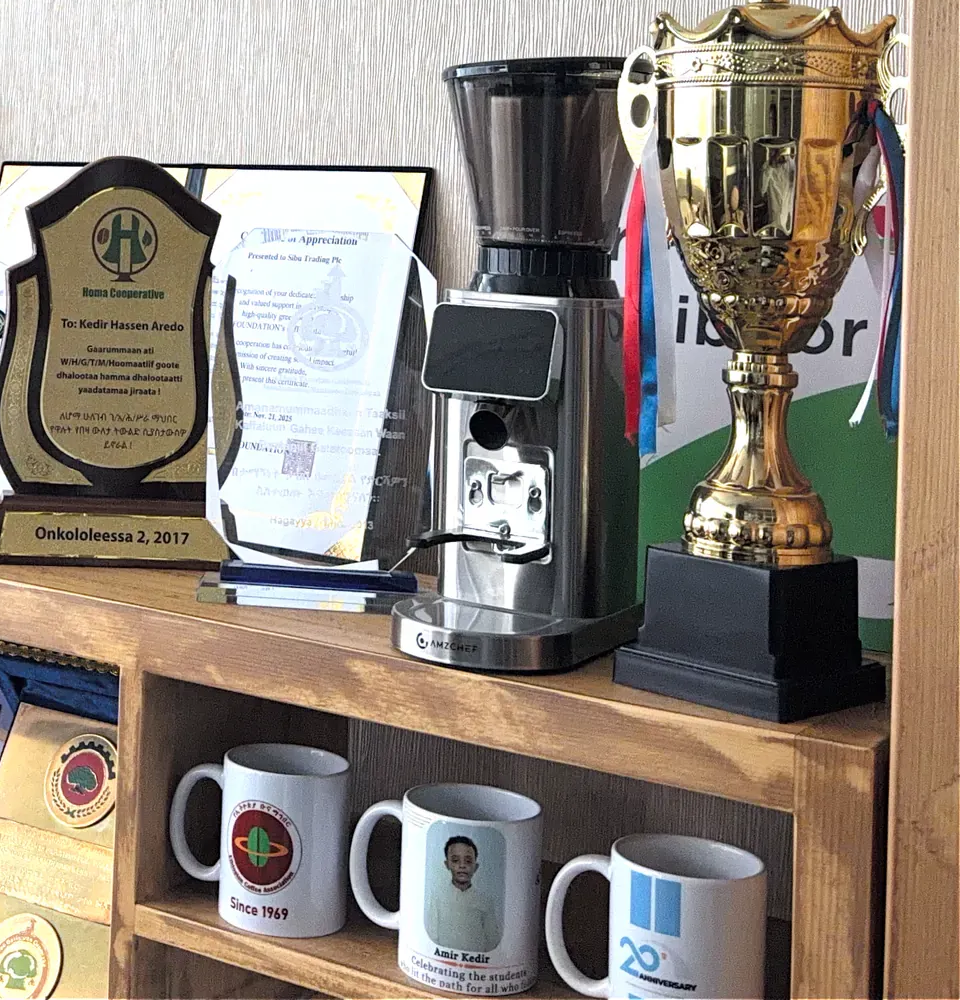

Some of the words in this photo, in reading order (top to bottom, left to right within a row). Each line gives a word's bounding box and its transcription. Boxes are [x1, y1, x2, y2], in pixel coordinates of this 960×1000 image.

[298, 234, 358, 247] Appreciation
[248, 252, 279, 261] Presented
[288, 253, 302, 262] Sibu
[304, 254, 330, 264] Trading
[82, 287, 108, 298] Homa
[110, 288, 165, 300] Cooperative
[61, 318, 77, 329] To:
[79, 318, 109, 330] Kedir
[110, 320, 149, 331] Hassen
[151, 321, 185, 332] Aredo
[155, 361, 180, 370] goote
[278, 414, 293, 423] 2025
[35, 526, 133, 543] Onkololeessa
[136, 530, 150, 546] 2,
[153, 531, 190, 545] 2017
[430, 639, 478, 654] AMZCHEF
[230, 896, 258, 916] Since
[261, 906, 289, 920] 1969
[434, 947, 459, 960] Amir
[461, 953, 490, 964] Kedir
[411, 955, 466, 981] Celebrating
[469, 970, 486, 981] the
[489, 969, 527, 982] students
[421, 971, 436, 985] the
[466, 982, 481, 993] for
[484, 983, 498, 994] all
[501, 981, 519, 993] who
[638, 972, 697, 992] ANNIVERSARY
